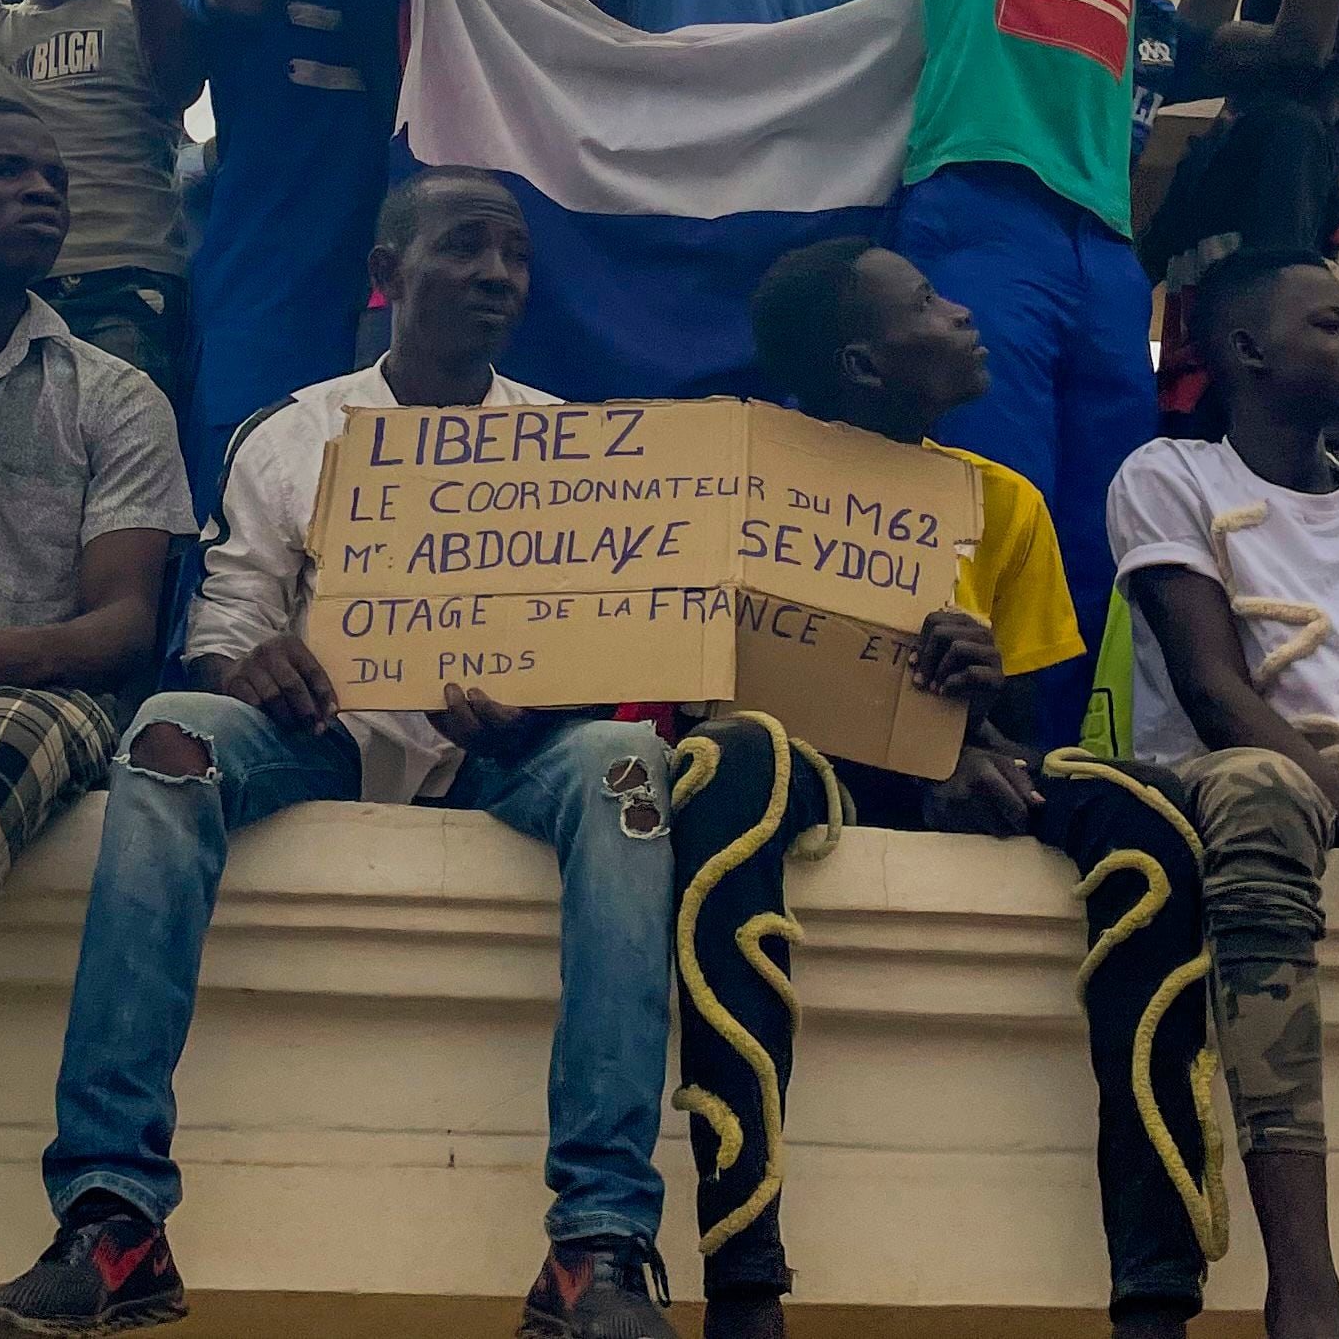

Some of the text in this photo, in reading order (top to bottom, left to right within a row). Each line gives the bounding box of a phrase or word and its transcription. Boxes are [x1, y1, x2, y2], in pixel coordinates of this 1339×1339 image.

[369, 408, 645, 467] LIBEREZ
[349, 475, 939, 549] LE COORDONNATEUR DU M62
[406, 521, 692, 575] ABDOULAYE
[738, 519, 921, 596] SEYDOU
[341, 594, 494, 638] OTAGE
[526, 598, 576, 622] DE
[597, 597, 632, 618] LA
[648, 586, 827, 646] FRANCE
[346, 650, 536, 684] DU PNDS
